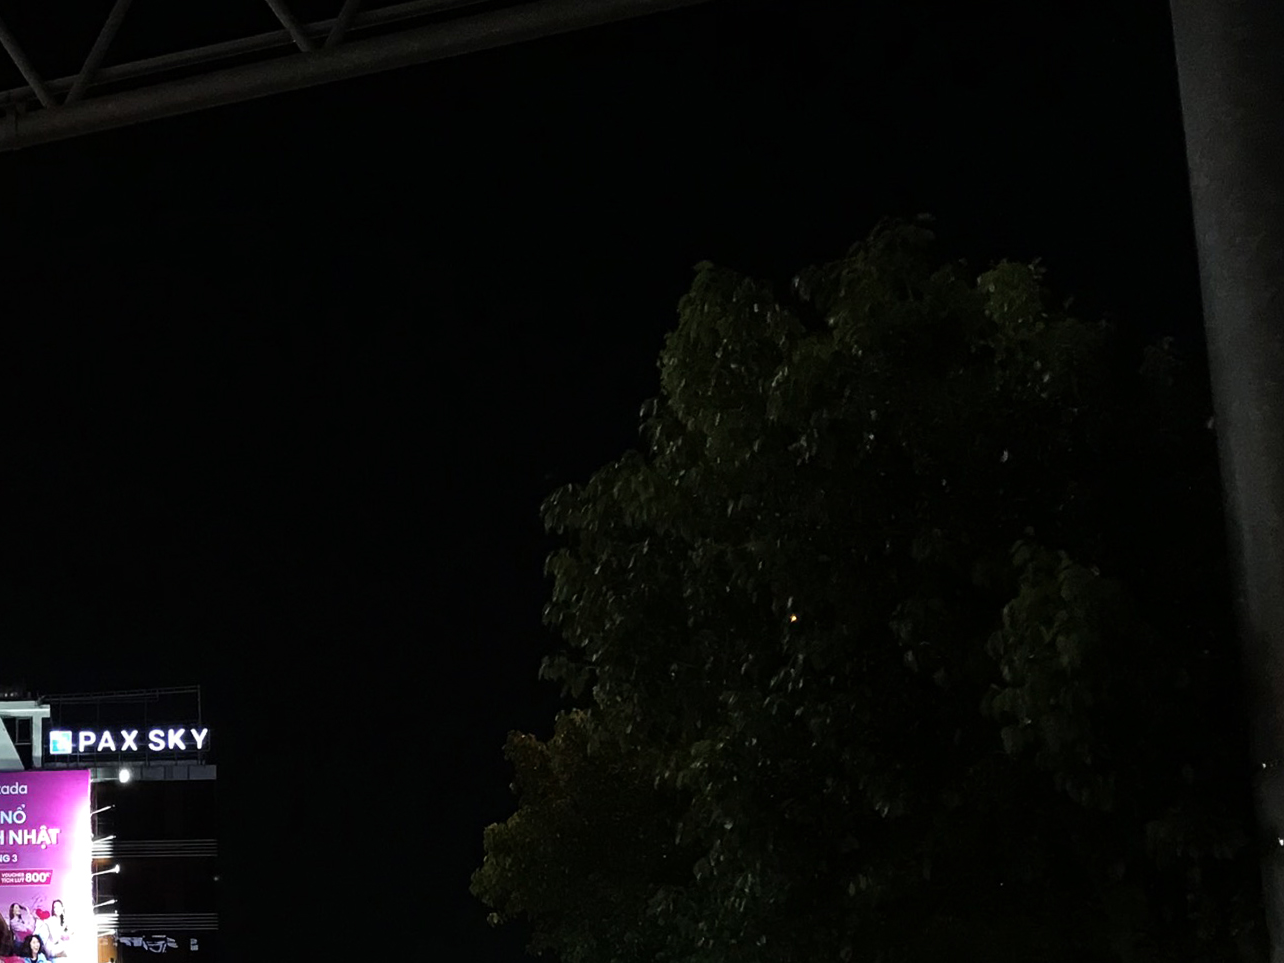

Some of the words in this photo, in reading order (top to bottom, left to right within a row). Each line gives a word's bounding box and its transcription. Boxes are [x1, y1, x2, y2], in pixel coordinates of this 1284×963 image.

[78, 730, 139, 752] PAX
[148, 728, 208, 751] SKY
[0, 804, 27, 824] NỔ
[8, 825, 61, 849] NHẬT
[11, 854, 18, 862] 3
